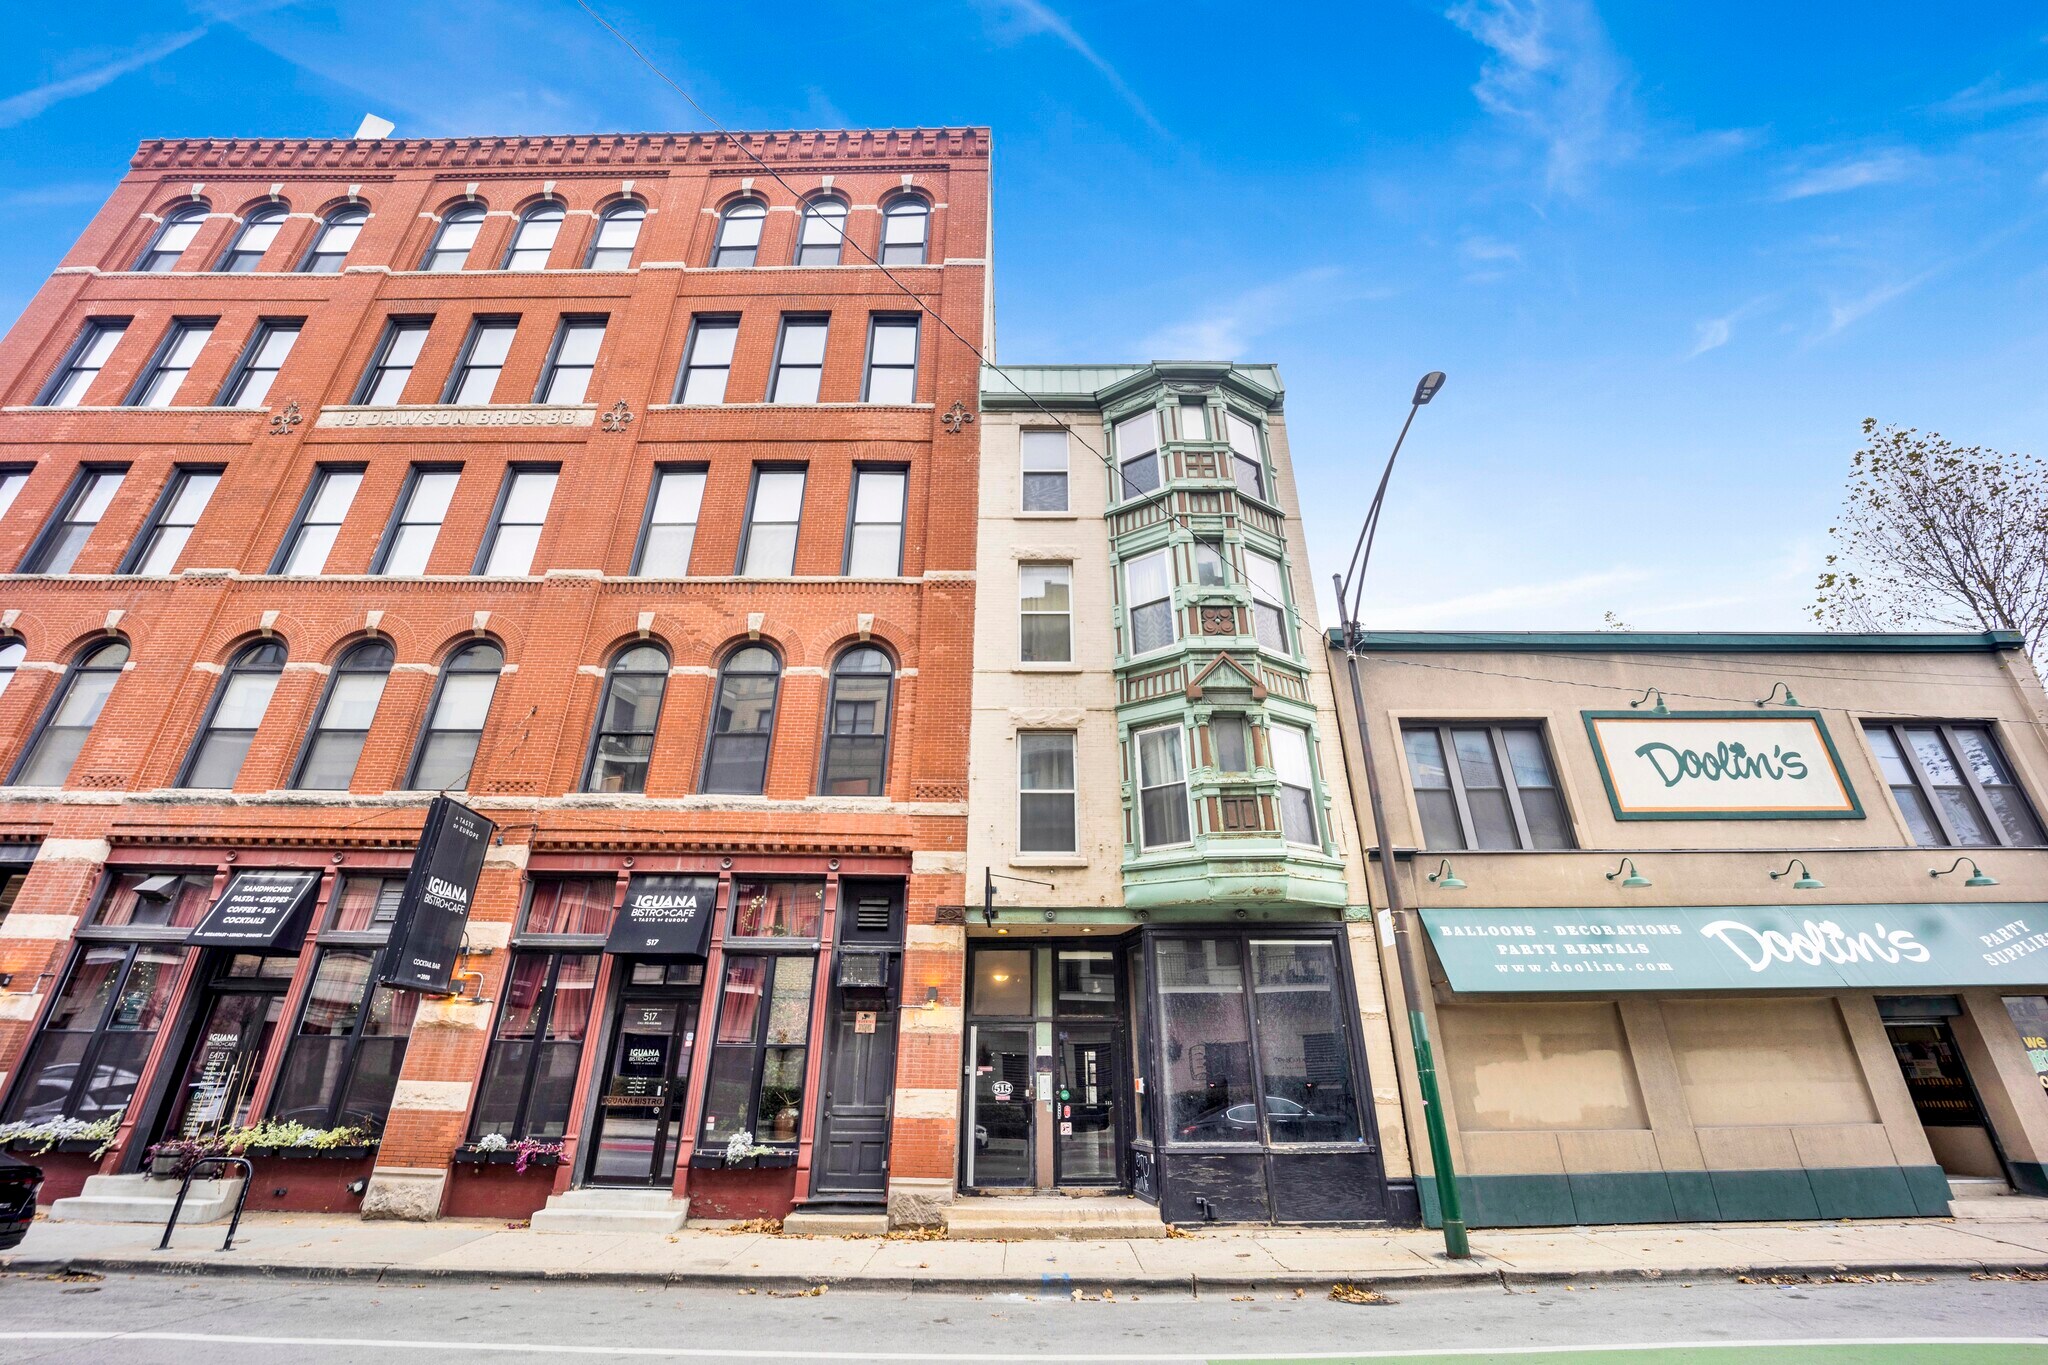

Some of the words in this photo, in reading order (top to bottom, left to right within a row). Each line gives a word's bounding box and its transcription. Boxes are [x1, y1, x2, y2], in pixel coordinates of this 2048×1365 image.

[334, 412, 360, 427] 18
[365, 410, 469, 426] DAWSON
[547, 410, 577, 425] 88
[1634, 740, 1808, 788] Doolin's
[460, 816, 475, 829] TASTE
[459, 825, 479, 840] EUROPE
[242, 885, 293, 893] SANDWICHES
[428, 875, 467, 904] IGUANA
[423, 893, 466, 915] BISTRO+CAFE
[634, 894, 697, 908] IGUANA
[261, 906, 276, 914] TEA
[630, 908, 696, 917] BISTRO+CAFE
[1439, 925, 1537, 937] BALLOONS
[1553, 924, 1683, 936] DECORATIONS
[1979, 919, 2031, 948] PARTY
[646, 938, 660, 946] 517
[1699, 919, 1932, 973] Doolin's
[1496, 943, 1558, 955] PARTY
[1563, 943, 1650, 955] RENTALS
[413, 958, 431, 968] COCKTAIL
[431, 962, 441, 970] BAR
[1494, 959, 1674, 974] www.doolins.com
[643, 1012, 658, 1021] 517
[2022, 1036, 2047, 1048] we
[208, 1051, 226, 1060] EATS
[630, 1049, 659, 1057] IGUANA
